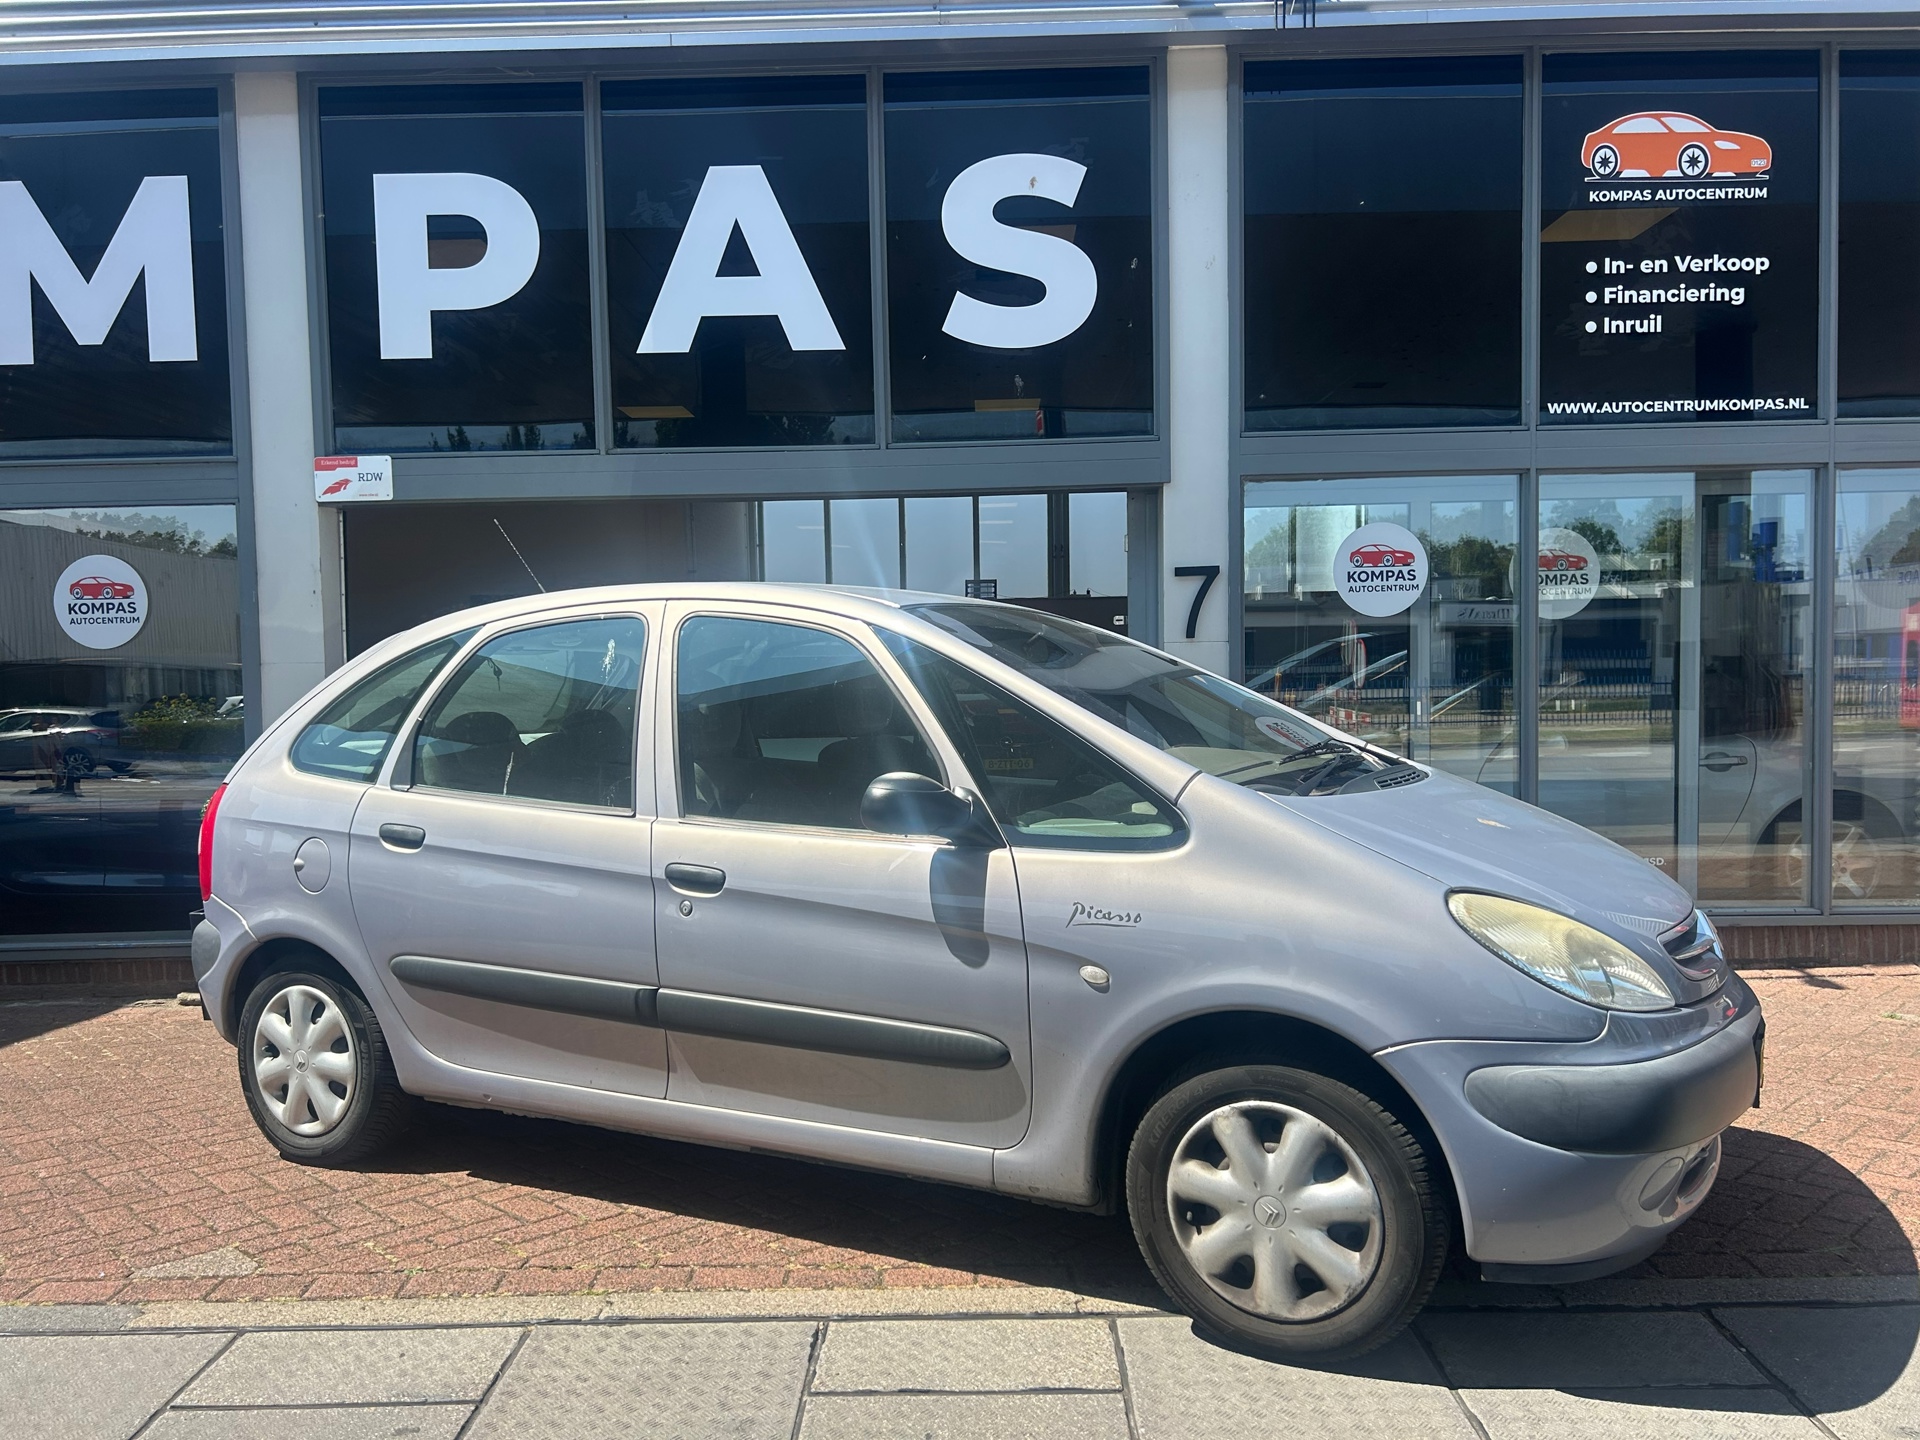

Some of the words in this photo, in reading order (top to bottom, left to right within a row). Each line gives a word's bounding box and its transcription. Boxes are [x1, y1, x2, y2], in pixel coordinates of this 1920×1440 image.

[1589, 189, 1652, 202] KOMPAS
[1655, 187, 1768, 201] AUTOCENTRUM
[1603, 257, 1634, 274] In-
[1640, 259, 1668, 273] en
[1674, 254, 1770, 275] Verkoop
[1603, 283, 1745, 306] Financiering
[1603, 314, 1662, 334] Inruil
[1547, 397, 1810, 415] WWW.AUTOCENTRUMKOMPAS.NL
[358, 472, 383, 482] RDW
[1347, 569, 1417, 583] KOMPAS
[1348, 584, 1420, 593] AUTOCENTRUM
[68, 601, 137, 615] KOMPAS
[1174, 565, 1220, 638] 7
[69, 616, 140, 625] AUTOCENTRUM
[1065, 901, 1142, 929] Picasso
